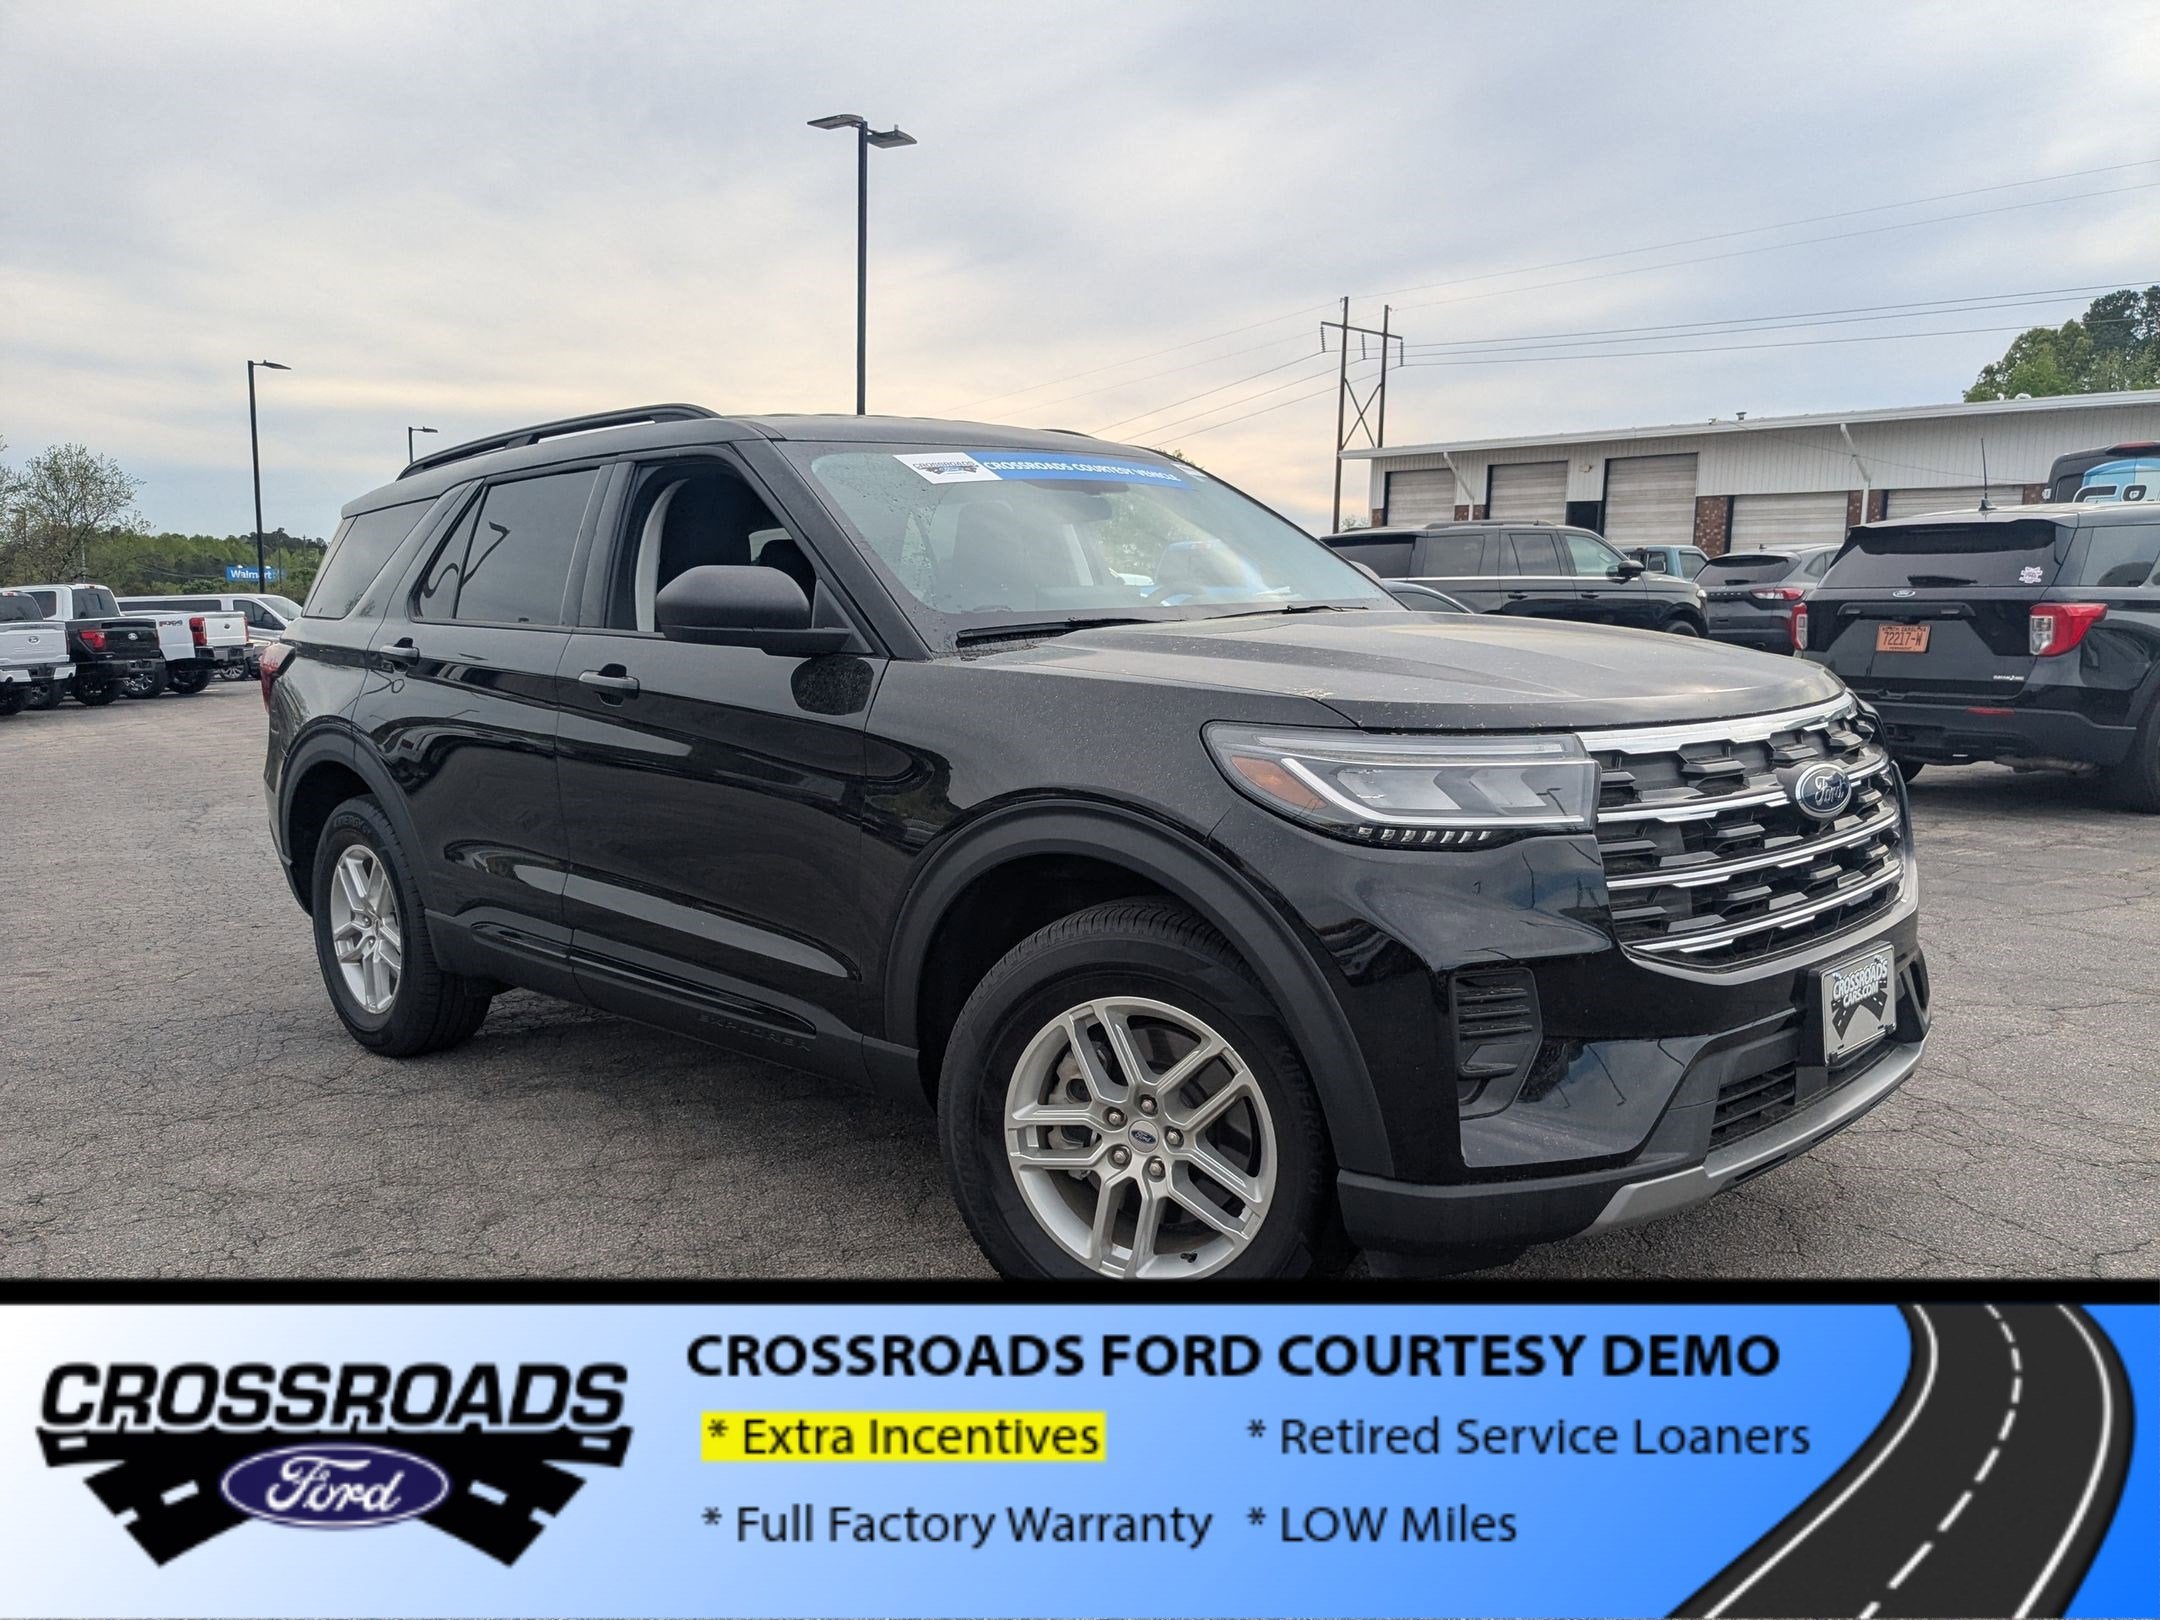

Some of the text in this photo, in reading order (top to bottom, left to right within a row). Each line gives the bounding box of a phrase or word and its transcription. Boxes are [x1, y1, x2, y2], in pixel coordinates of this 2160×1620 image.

[983, 461, 1073, 471] CROSSROADS
[1072, 463, 1135, 475] COURTESY
[230, 569, 272, 579] Walmrt
[1815, 775, 1847, 806] Ford
[1833, 960, 1888, 1000] CROSSROADS
[1843, 980, 1879, 1008] CARS.COM
[1135, 1131, 1152, 1143] Ford
